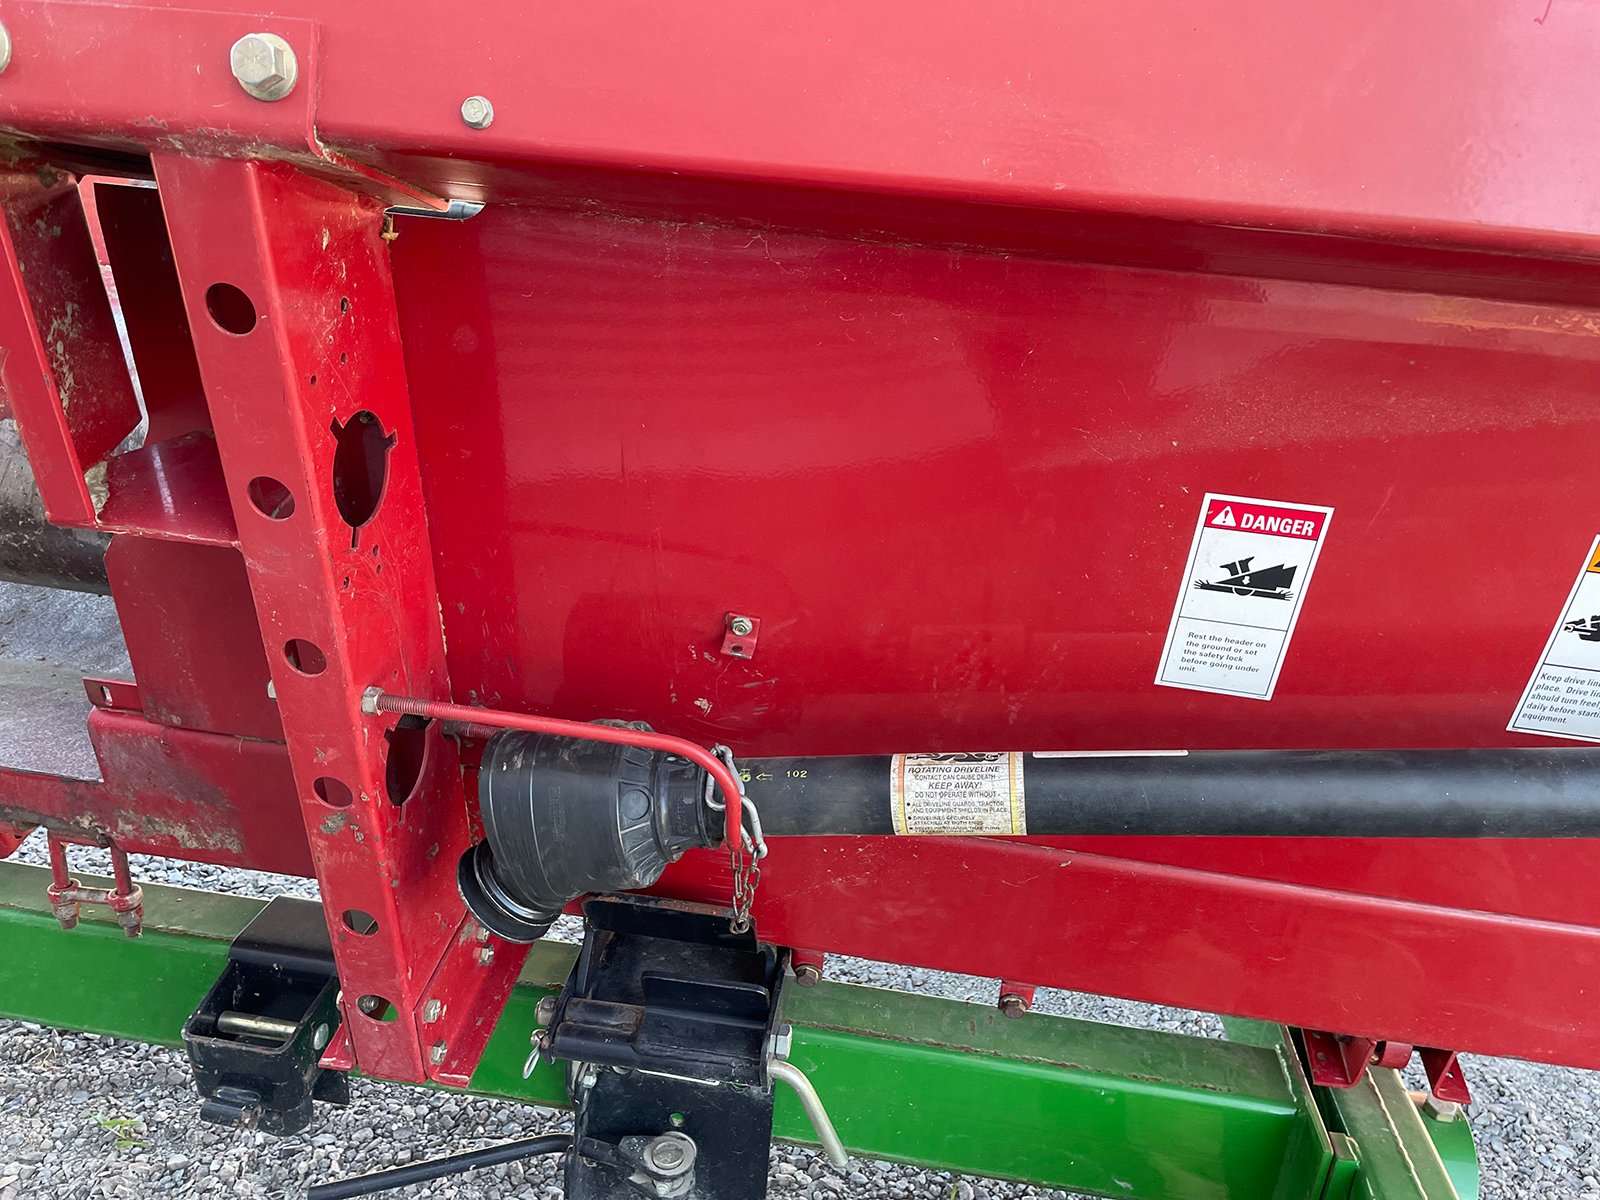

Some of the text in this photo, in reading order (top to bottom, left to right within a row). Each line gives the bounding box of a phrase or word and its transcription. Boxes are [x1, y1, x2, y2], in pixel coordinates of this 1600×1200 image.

[1240, 513, 1315, 536] DANGER
[1188, 632, 1206, 640] Rest
[1224, 637, 1253, 646] header
[1201, 643, 1232, 652] ground
[1199, 651, 1224, 660] safety
[1226, 654, 1243, 662] lock
[1181, 657, 1259, 673] before going under
[1541, 673, 1562, 683] Keep
[1564, 676, 1586, 685] drive
[1535, 683, 1561, 692] place.
[1566, 687, 1589, 696] Drive
[1531, 693, 1560, 702] should
[1561, 697, 1578, 705] turn
[1527, 702, 1548, 712] daily
[1549, 705, 1576, 714] before
[1522, 713, 1567, 723] equipment.
[786, 770, 808, 778] 102
